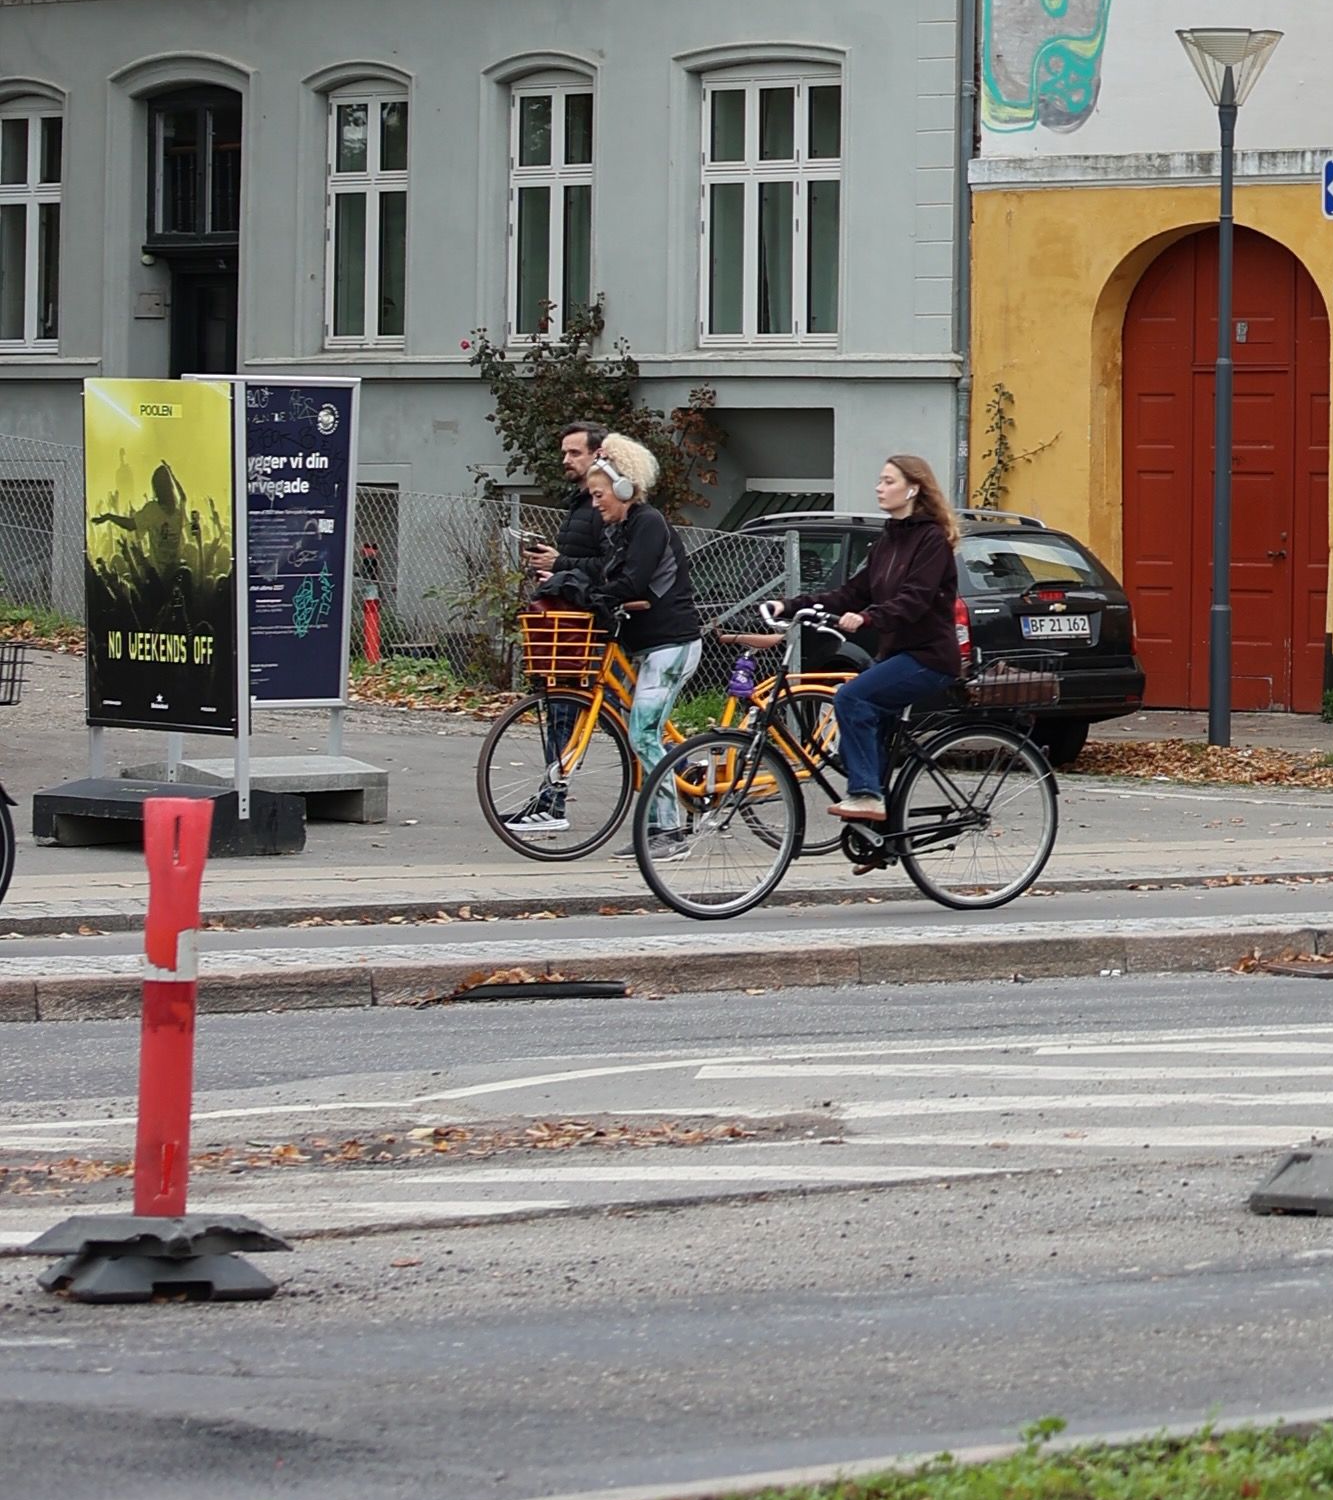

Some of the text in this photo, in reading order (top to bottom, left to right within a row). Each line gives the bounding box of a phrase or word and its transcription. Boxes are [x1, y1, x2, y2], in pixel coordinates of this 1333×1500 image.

[140, 404, 173, 417] POOLEN
[289, 452, 303, 469] vi
[305, 452, 329, 469] din
[1031, 617, 1087, 633] BF 21 162
[108, 630, 214, 665] NO WEEKENDS OFF
